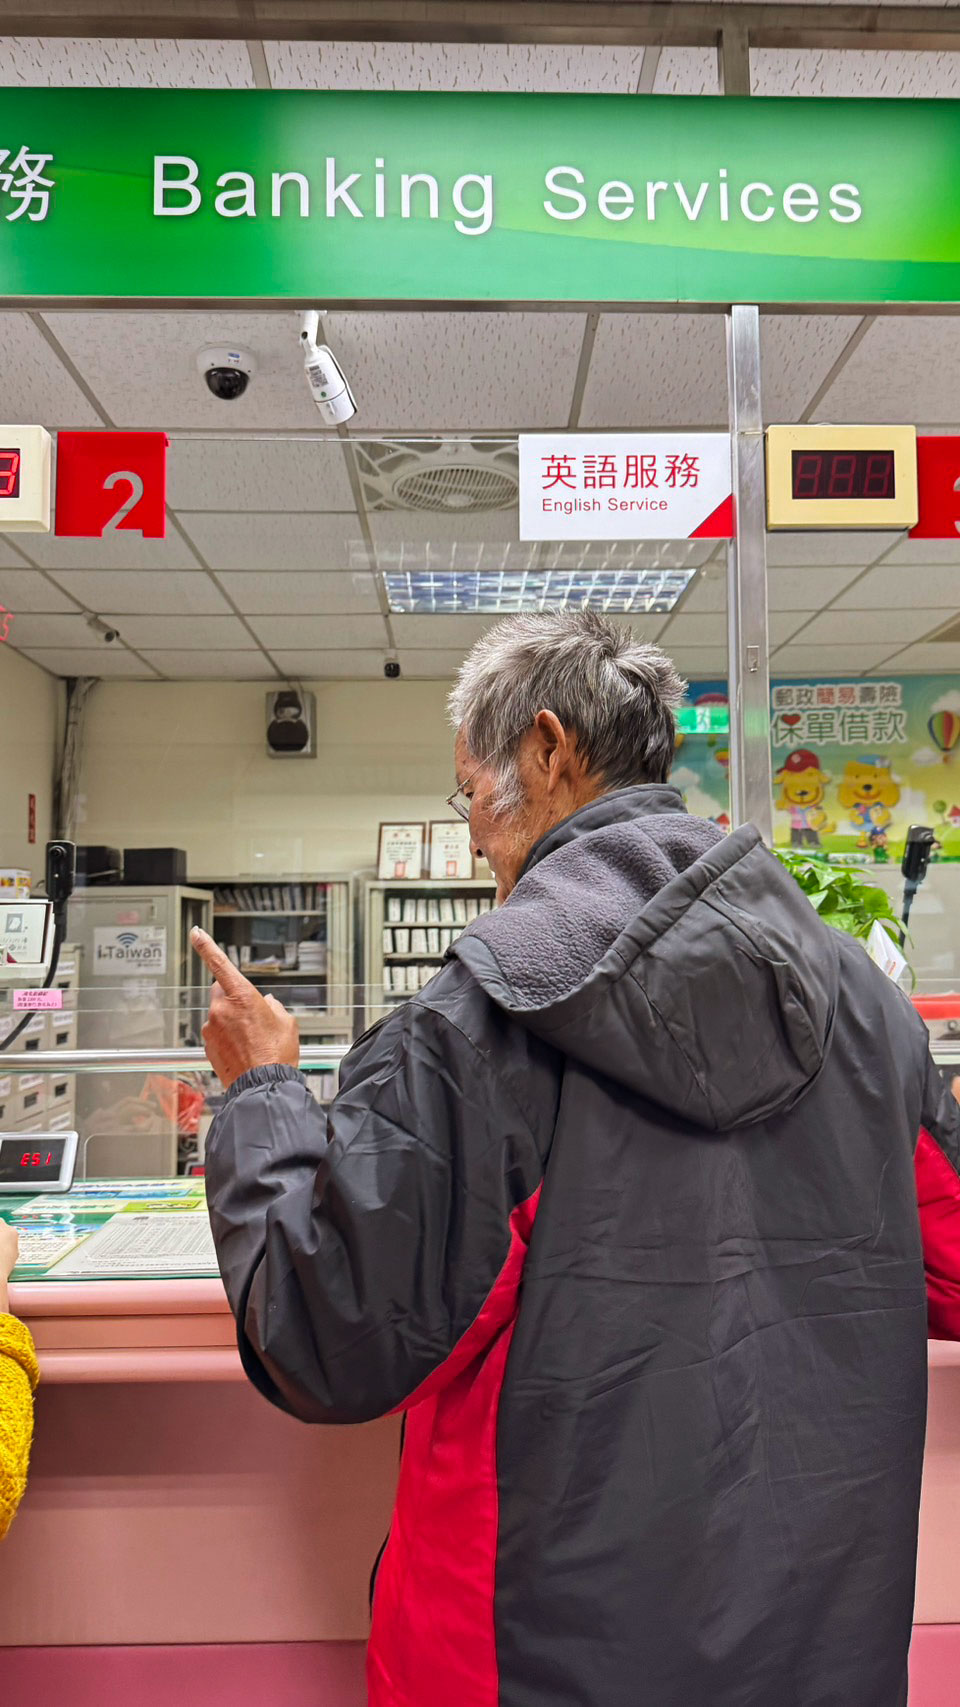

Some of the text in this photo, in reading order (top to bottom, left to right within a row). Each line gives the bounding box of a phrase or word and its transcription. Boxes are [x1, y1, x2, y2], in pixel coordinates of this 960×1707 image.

[152, 155, 863, 236] Banking Services
[540, 452, 701, 490] 英語服務
[102, 470, 145, 537] 2
[541, 497, 668, 513] English Service
[775, 685, 900, 707] 郵政簡易壽險
[771, 711, 906, 744] 保單借款
